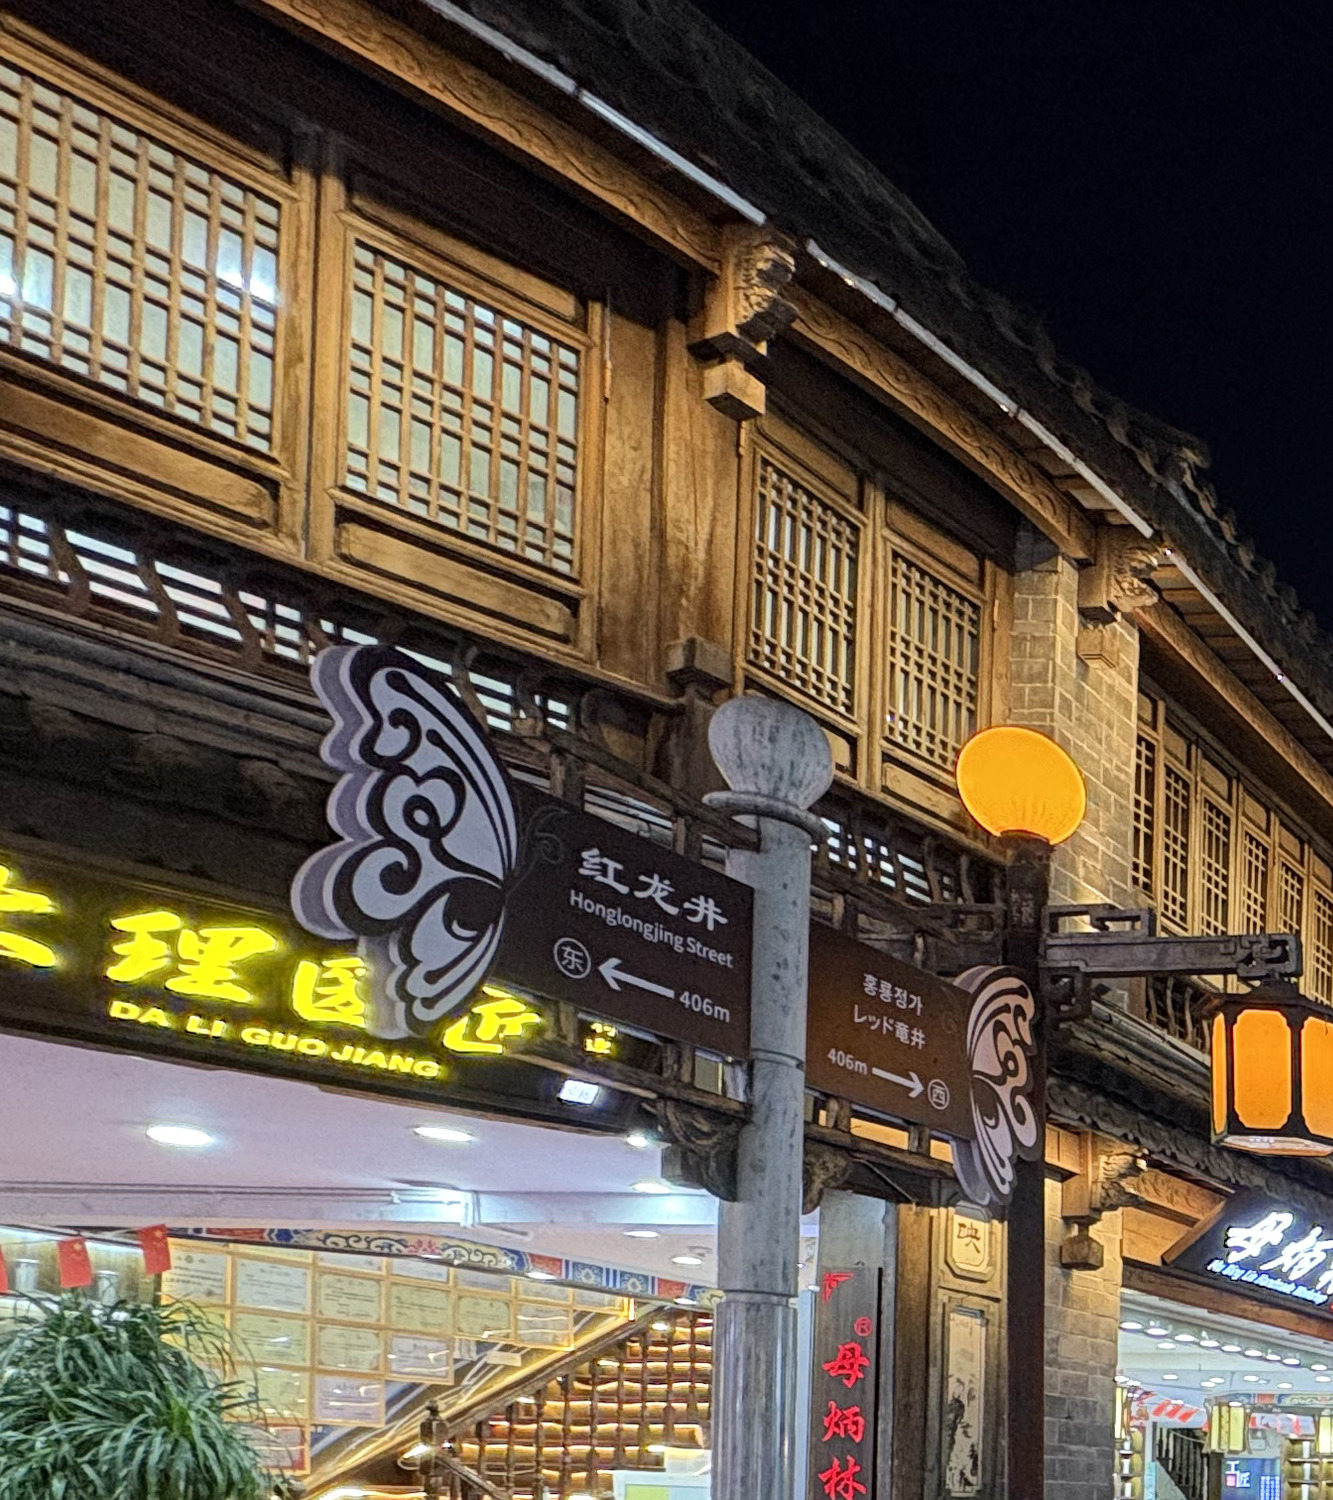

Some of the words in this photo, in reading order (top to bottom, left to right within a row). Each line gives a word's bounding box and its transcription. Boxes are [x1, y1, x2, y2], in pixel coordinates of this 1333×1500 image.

[578, 848, 729, 931] 红龙井
[570, 889, 684, 954] Honglongjing
[686, 936, 734, 969] Street
[679, 991, 731, 1023] 406m
[863, 973, 924, 1016] 홍룡정가
[108, 1000, 169, 1029] DA
[186, 1015, 227, 1039] LI
[240, 1027, 328, 1057] GUO
[331, 1044, 442, 1079] JIANG
[853, 1004, 926, 1050] レッド竜井
[827, 1048, 869, 1075] 406m
[956, 1222, 983, 1254] 映
